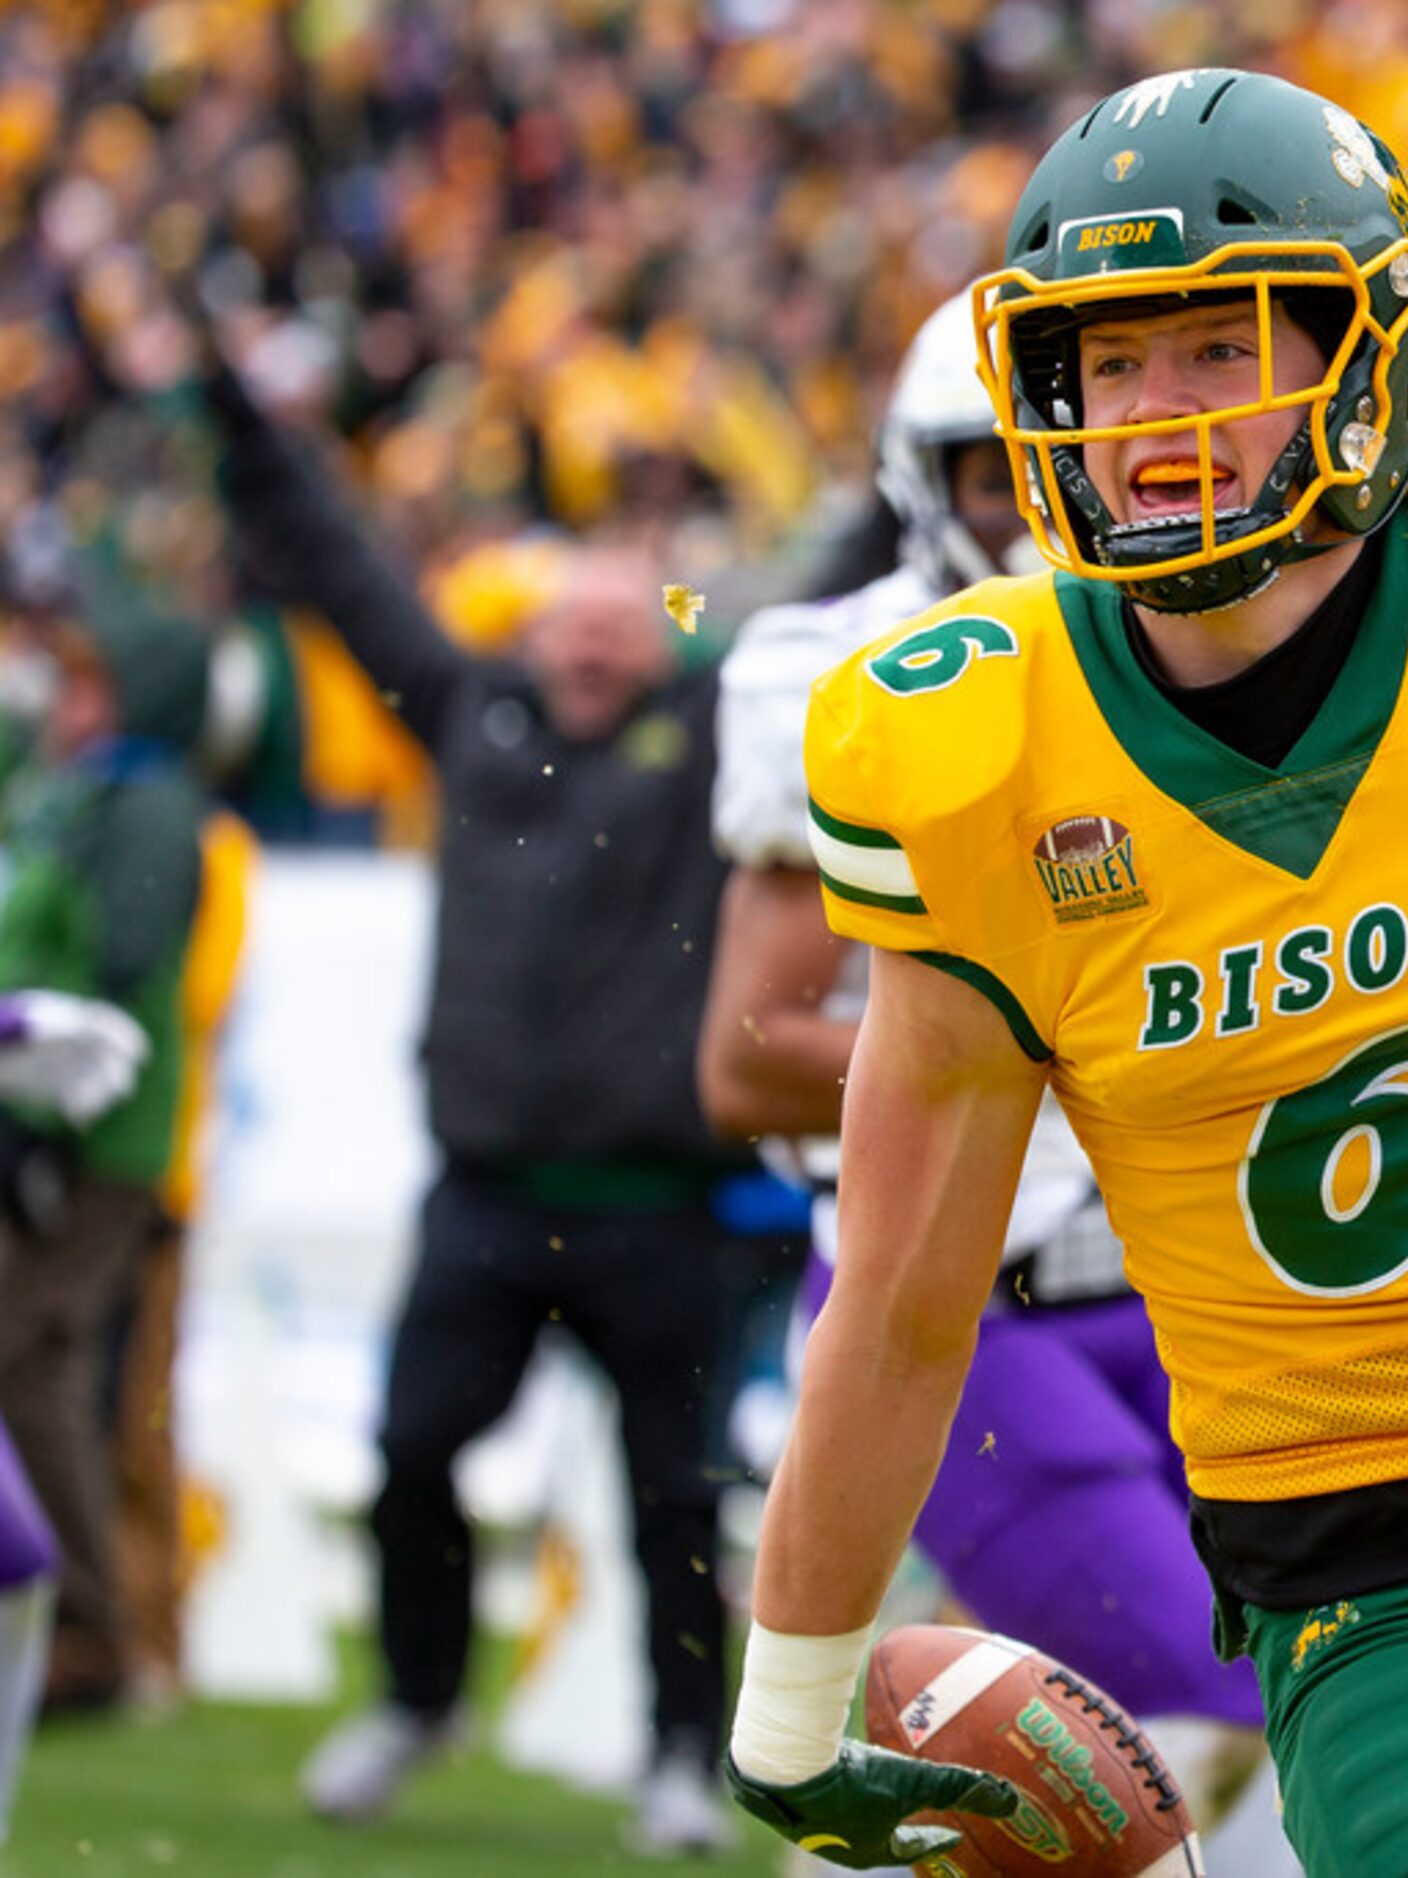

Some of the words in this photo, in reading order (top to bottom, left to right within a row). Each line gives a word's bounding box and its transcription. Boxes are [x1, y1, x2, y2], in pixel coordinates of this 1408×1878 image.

[1077, 220, 1156, 252] BISON
[1049, 444, 1088, 494] ICIS
[864, 614, 1019, 698] 6
[1034, 836, 1138, 903] VALLEY
[1016, 1696, 1129, 1839] Wilson
